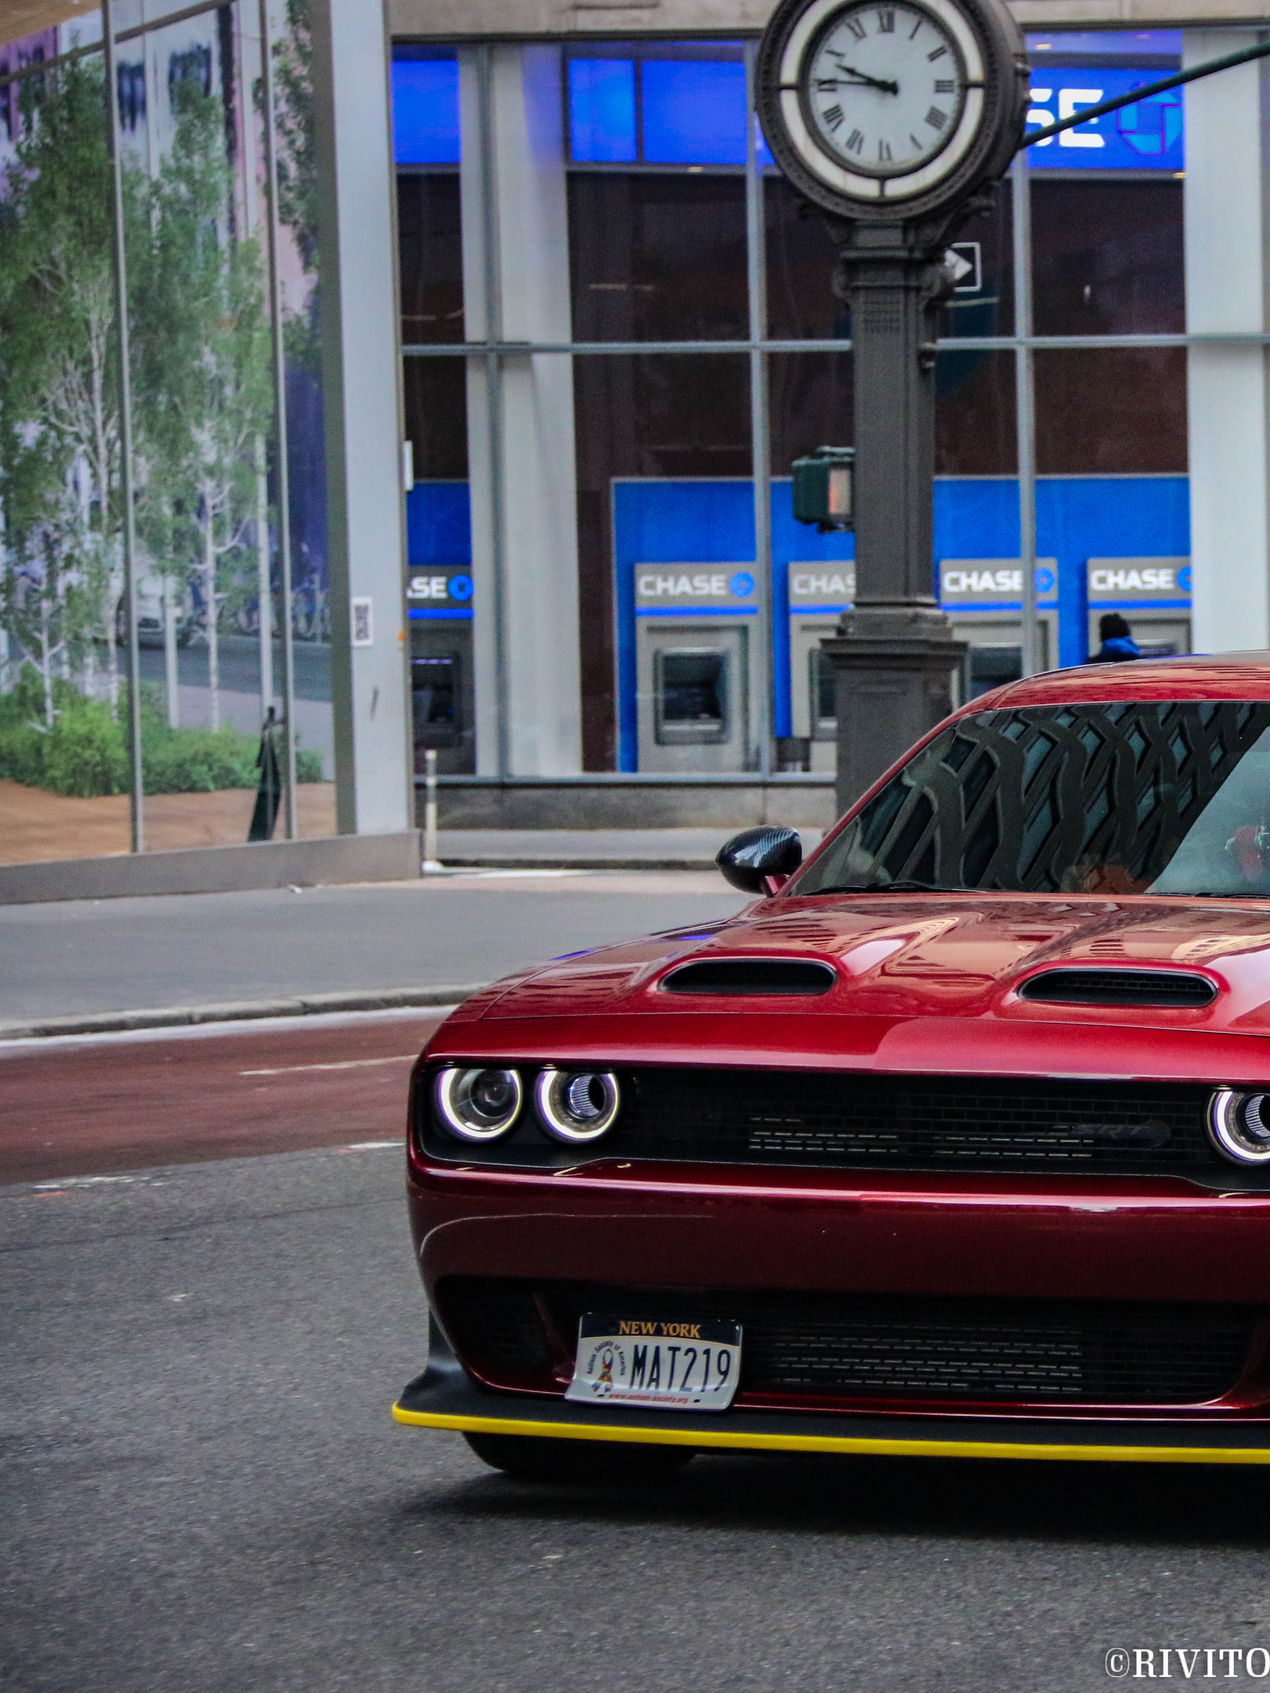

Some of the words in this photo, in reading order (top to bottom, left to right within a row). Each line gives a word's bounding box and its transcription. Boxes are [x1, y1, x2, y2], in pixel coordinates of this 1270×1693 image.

[406, 576, 448, 599] SE
[638, 574, 726, 597] CHASE
[792, 572, 855, 595] CHAS
[943, 569, 1023, 593] CHASE
[1090, 568, 1175, 590] CHASE
[618, 1321, 656, 1336] NEW
[660, 1322, 701, 1339] YORK
[587, 1353, 597, 1375] Autism
[595, 1340, 614, 1353] Society
[618, 1351, 627, 1376] America
[628, 1344, 731, 1393] MAT219
[608, 1393, 689, 1404] www.autism-society.org
